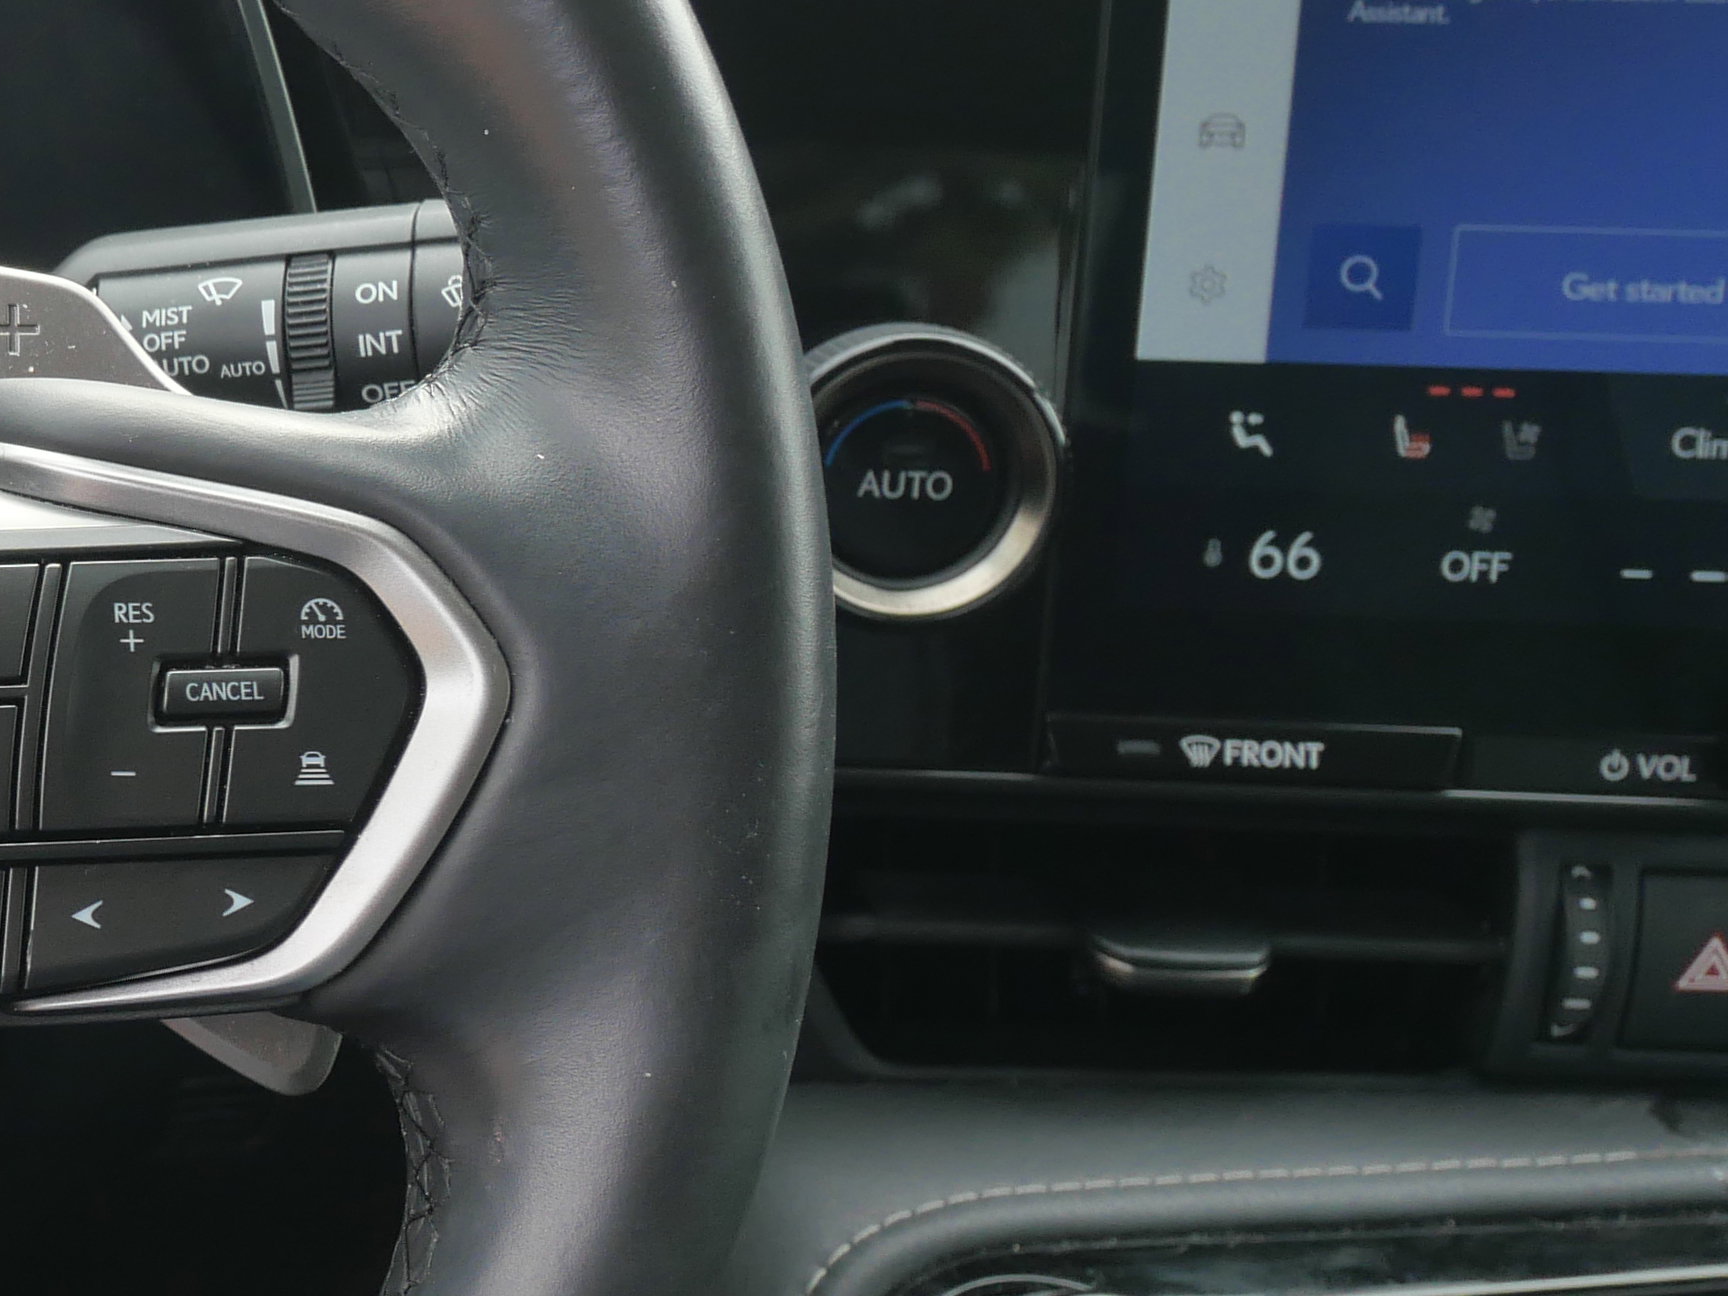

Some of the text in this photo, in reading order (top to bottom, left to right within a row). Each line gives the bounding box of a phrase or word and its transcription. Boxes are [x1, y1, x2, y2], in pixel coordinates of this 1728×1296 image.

[355, 280, 398, 304] ON
[1562, 271, 1727, 305] Get started
[142, 305, 193, 329] MIST
[143, 330, 187, 353] OFF
[358, 329, 403, 358] INT
[154, 354, 266, 379] UTO AUTO
[856, 469, 954, 502] AUTO
[1249, 531, 1322, 581] 66
[1440, 550, 1513, 584] OFF
[113, 602, 155, 624] RES
[300, 625, 347, 640] MODE
[185, 681, 264, 703] CANCEL
[1223, 739, 1325, 770] FRONT
[1637, 754, 1697, 783] VOL
